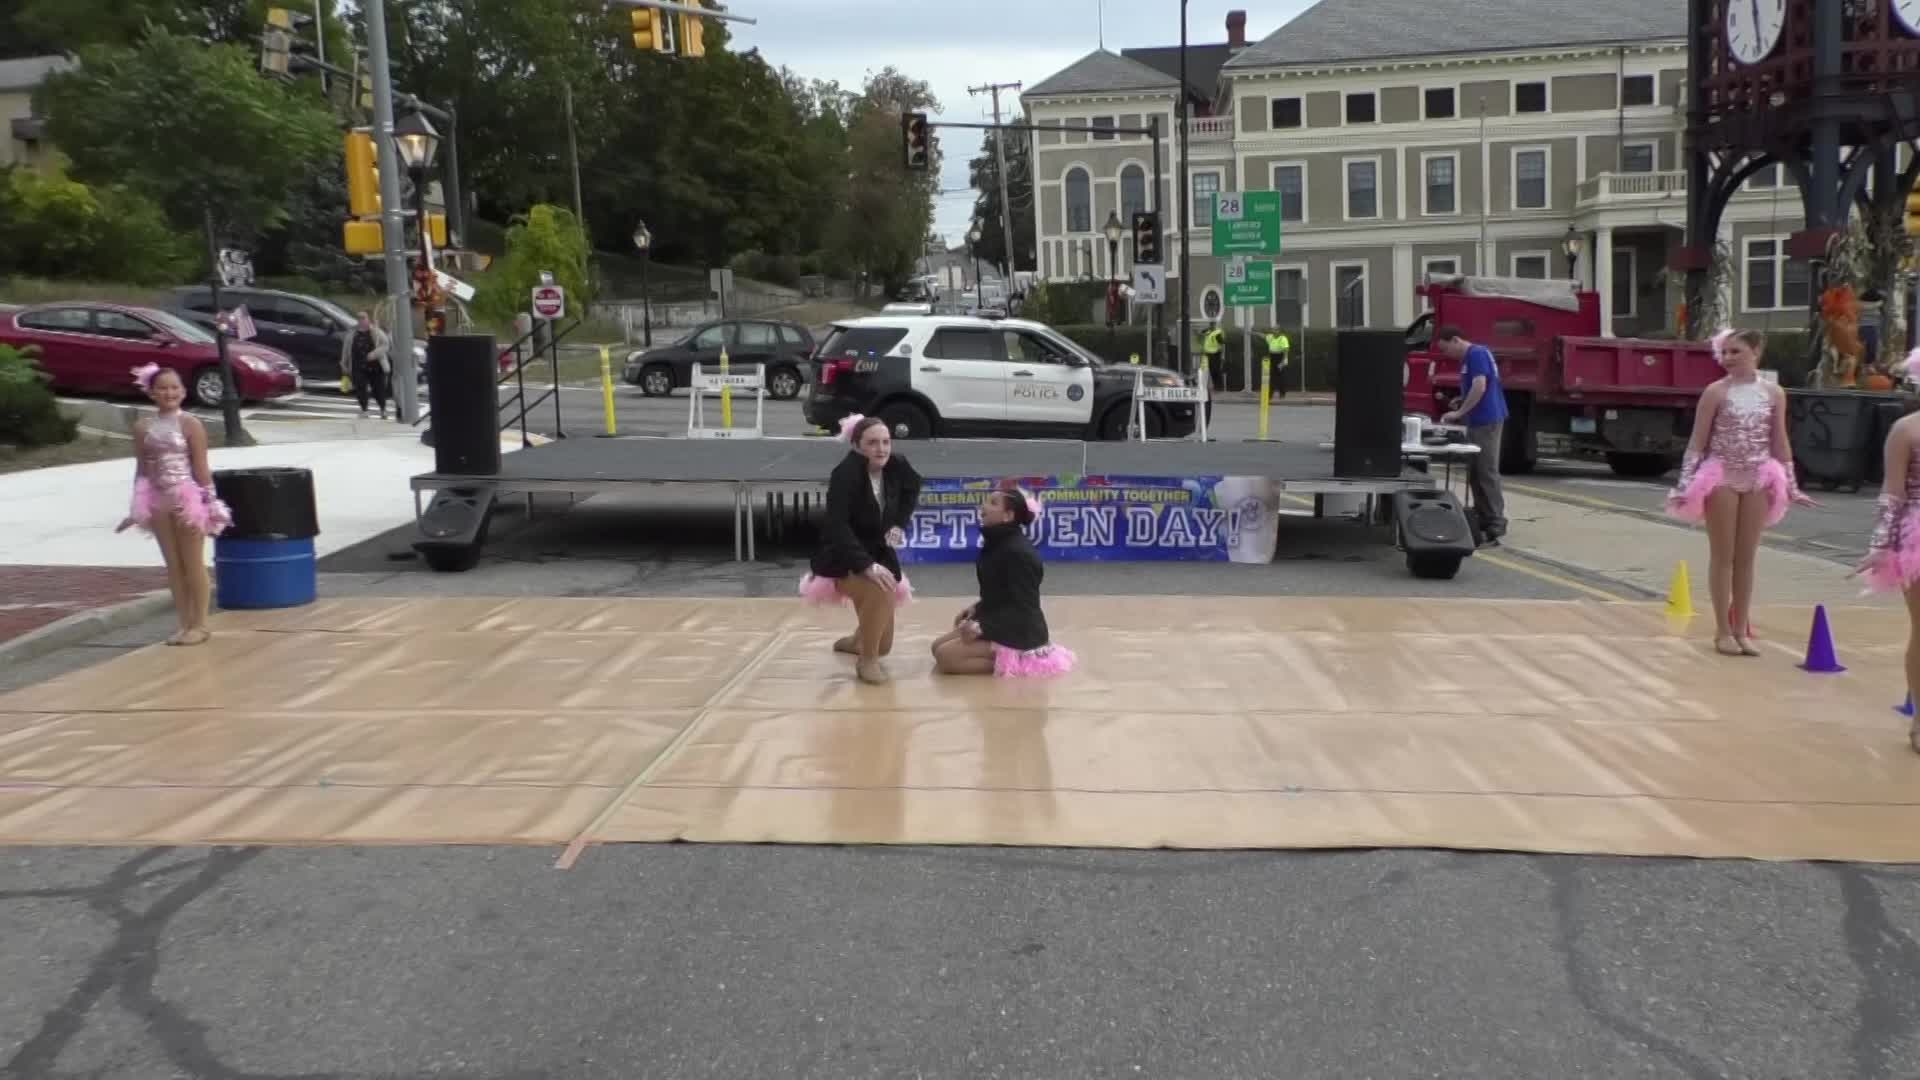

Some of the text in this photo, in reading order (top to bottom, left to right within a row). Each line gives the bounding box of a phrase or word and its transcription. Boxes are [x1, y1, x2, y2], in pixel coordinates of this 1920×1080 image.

[1220, 199, 1240, 214] 28
[1122, 488, 1190, 502] TOGETHER
[1126, 507, 1241, 547] DAY!
